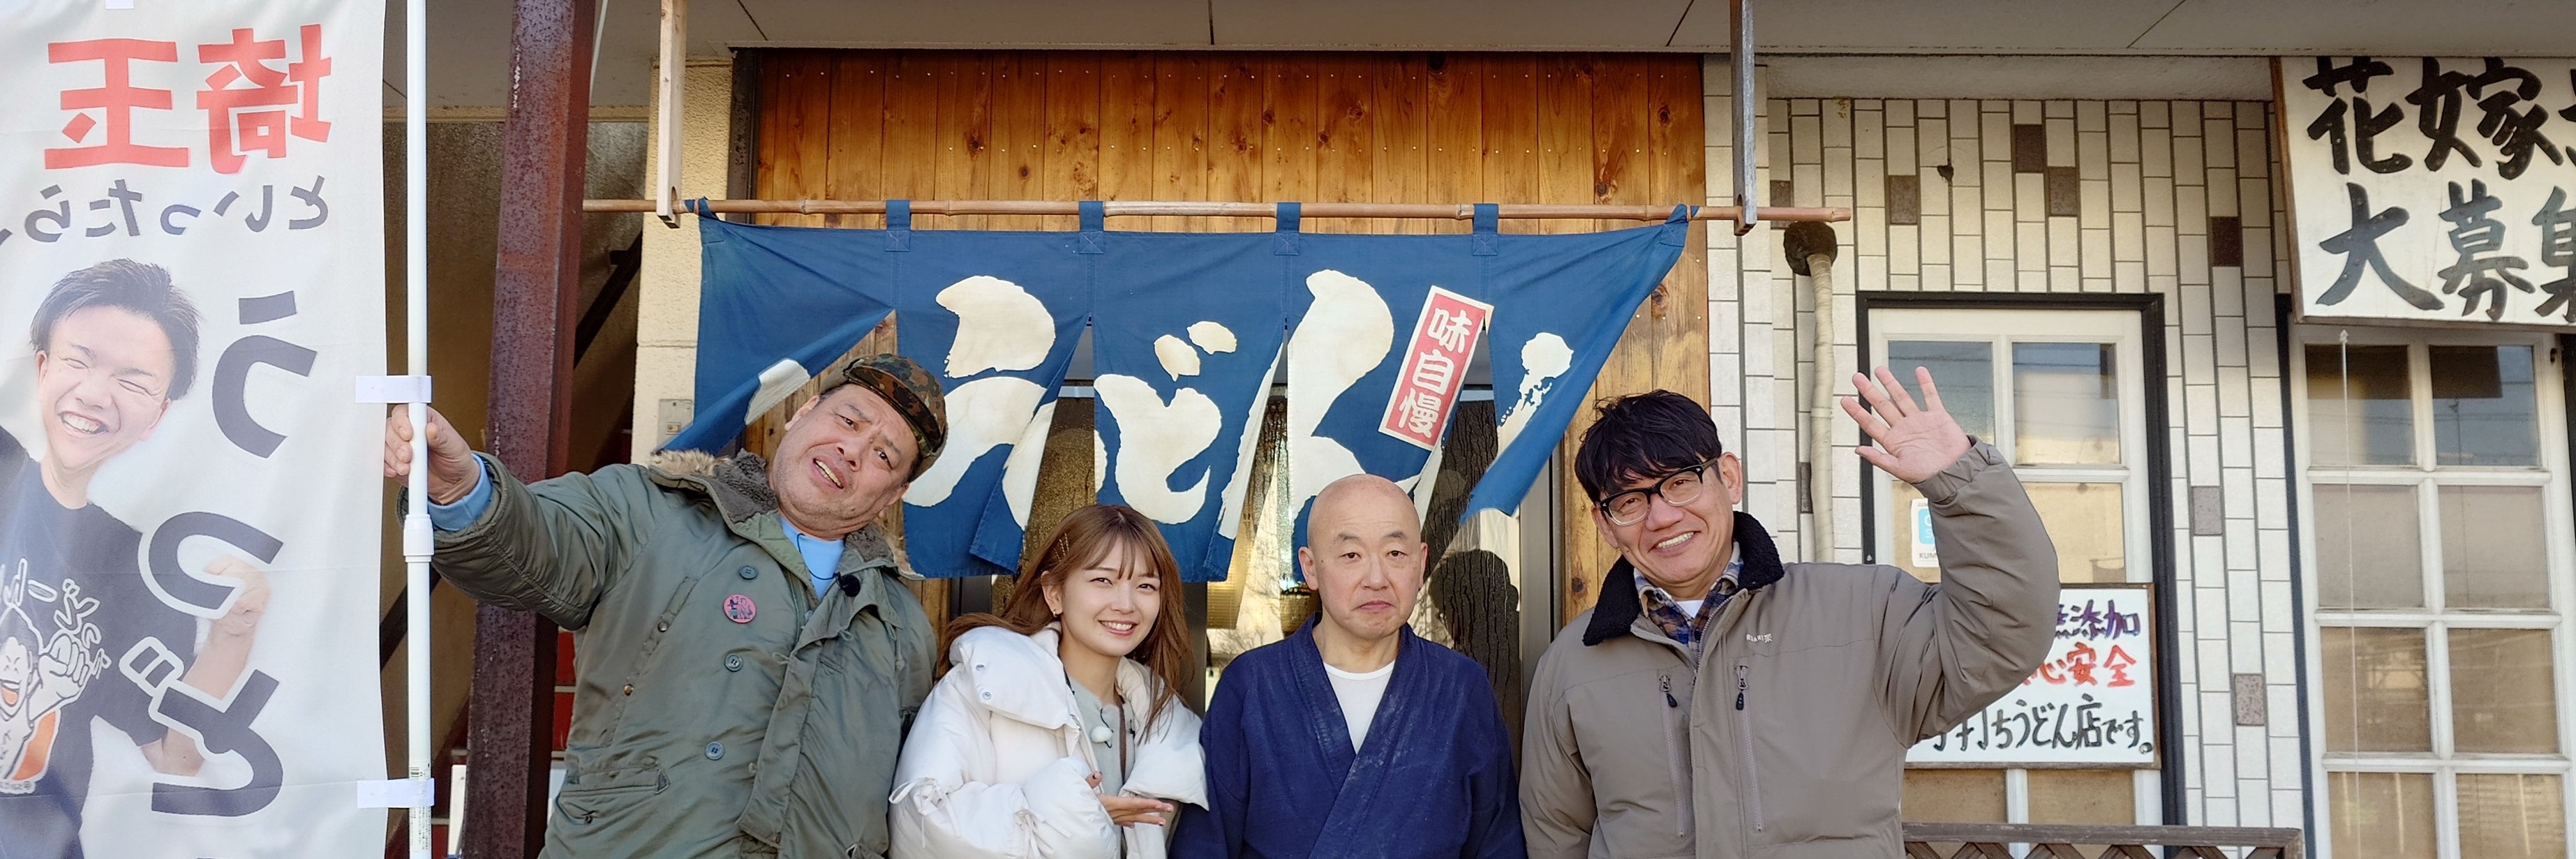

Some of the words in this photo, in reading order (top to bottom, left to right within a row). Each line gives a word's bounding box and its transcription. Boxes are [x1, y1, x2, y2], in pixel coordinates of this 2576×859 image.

[2302, 57, 2576, 180] 花嫁
[745, 269, 1574, 539] うどん
[1398, 307, 1473, 438] 味自慢
[2023, 642, 2136, 687] 心安全
